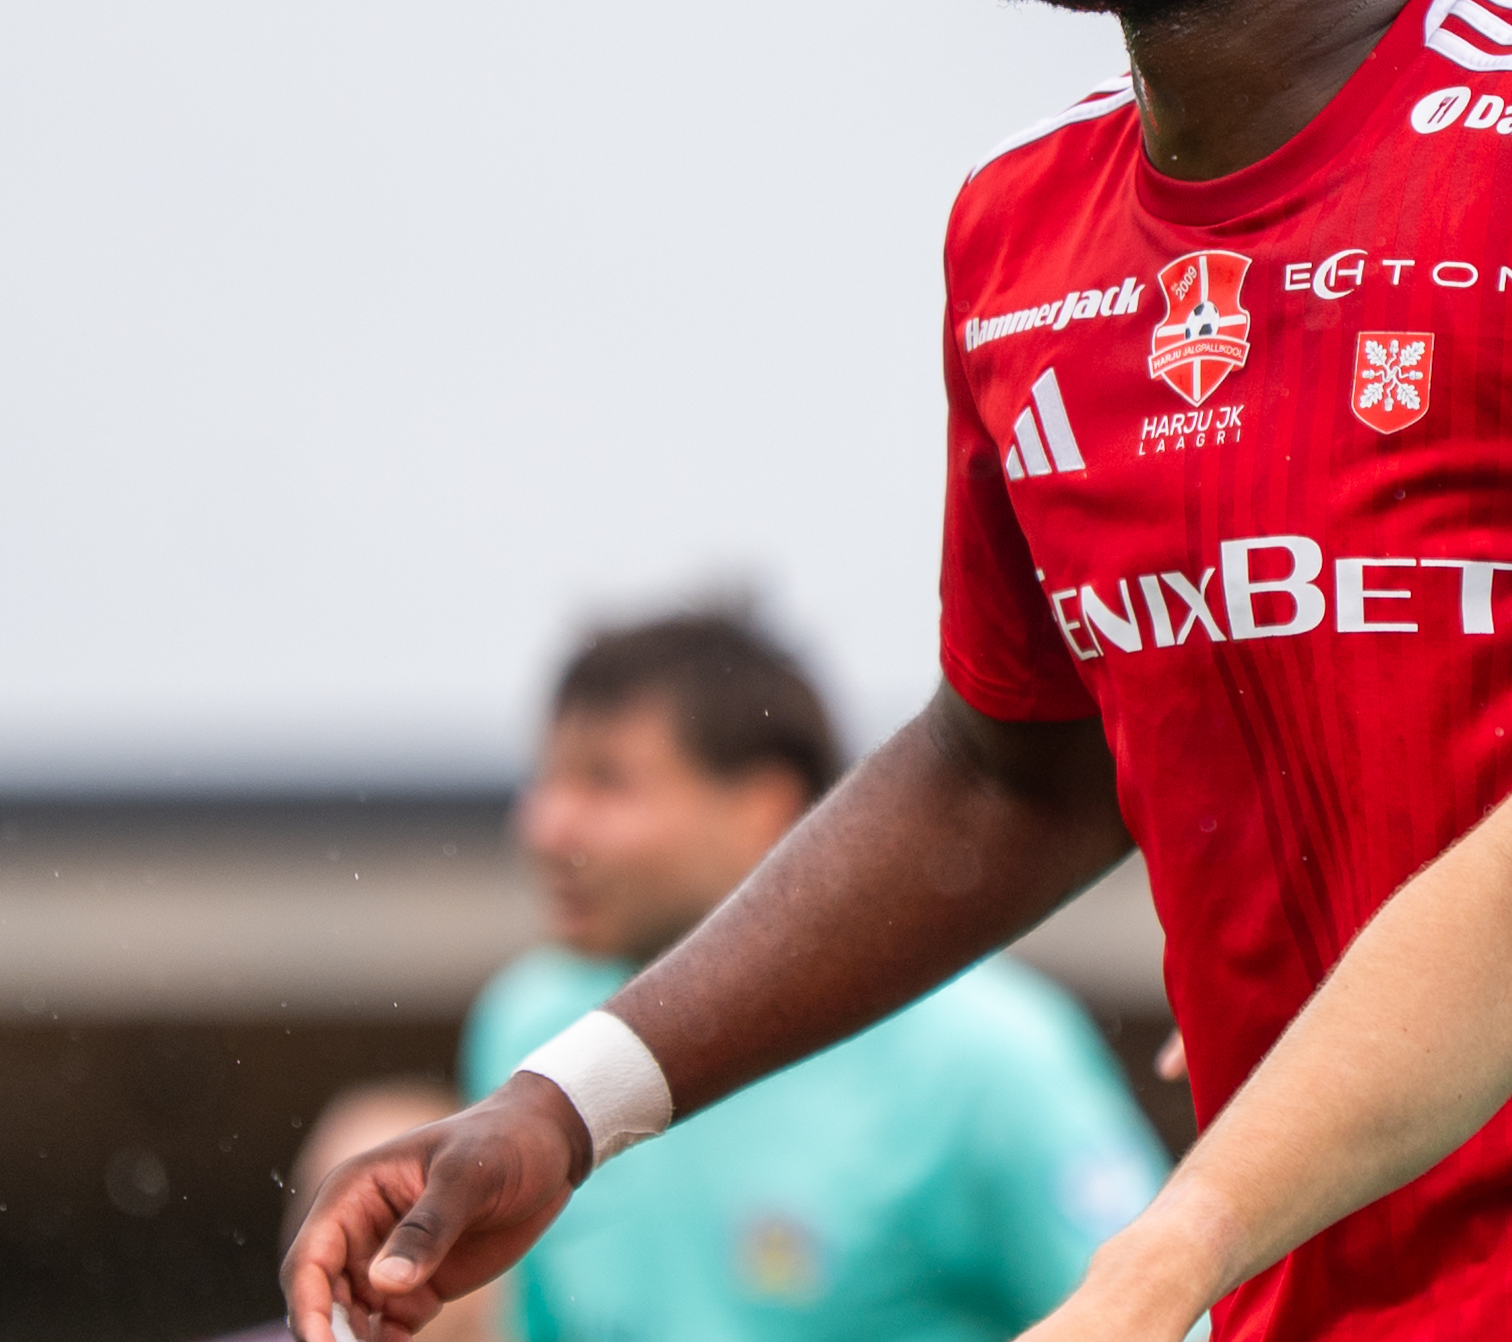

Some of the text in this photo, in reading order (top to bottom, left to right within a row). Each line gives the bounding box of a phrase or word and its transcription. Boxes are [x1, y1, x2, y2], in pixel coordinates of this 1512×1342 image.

[1176, 265, 1197, 301] 2009
[1153, 350, 1182, 370] HARJU
[1141, 405, 1245, 440] HARJU JK
[1139, 429, 1242, 456] LAAGRI
